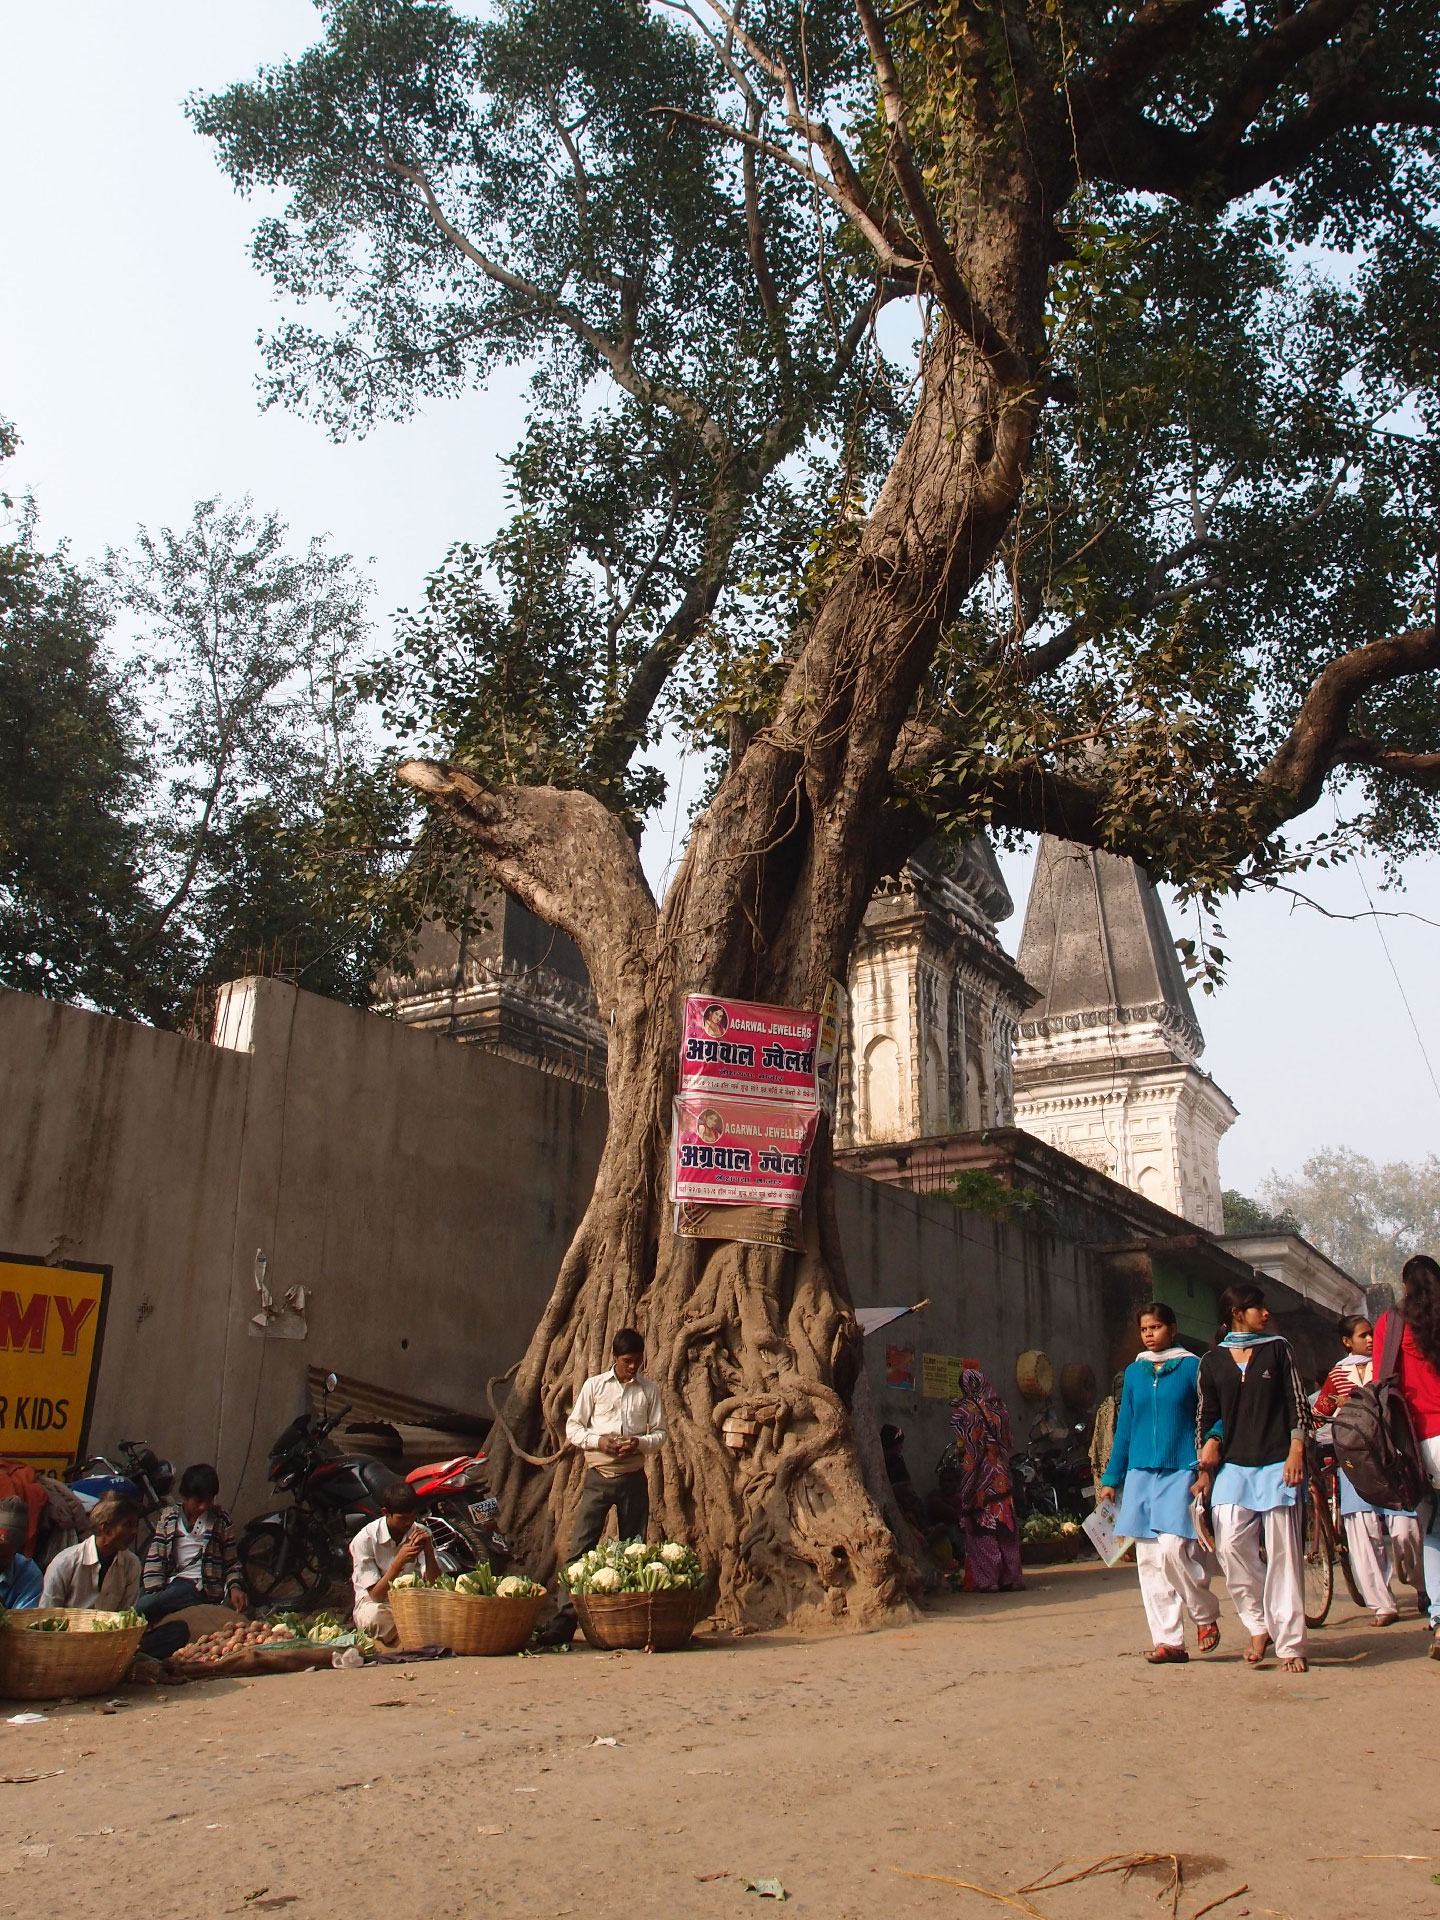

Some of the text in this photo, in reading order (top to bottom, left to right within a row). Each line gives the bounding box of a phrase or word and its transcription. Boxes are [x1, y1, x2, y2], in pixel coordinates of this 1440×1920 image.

[730, 1018, 767, 1033] AGARWAL
[768, 1024, 812, 1039] JEWELLERS
[686, 1038, 815, 1075] अग्रवाल ज्वेलर्स
[725, 1123, 762, 1137] AGARWAL
[680, 1144, 752, 1172] अग्रवाल
[14, 1397, 69, 1430] KIDS
